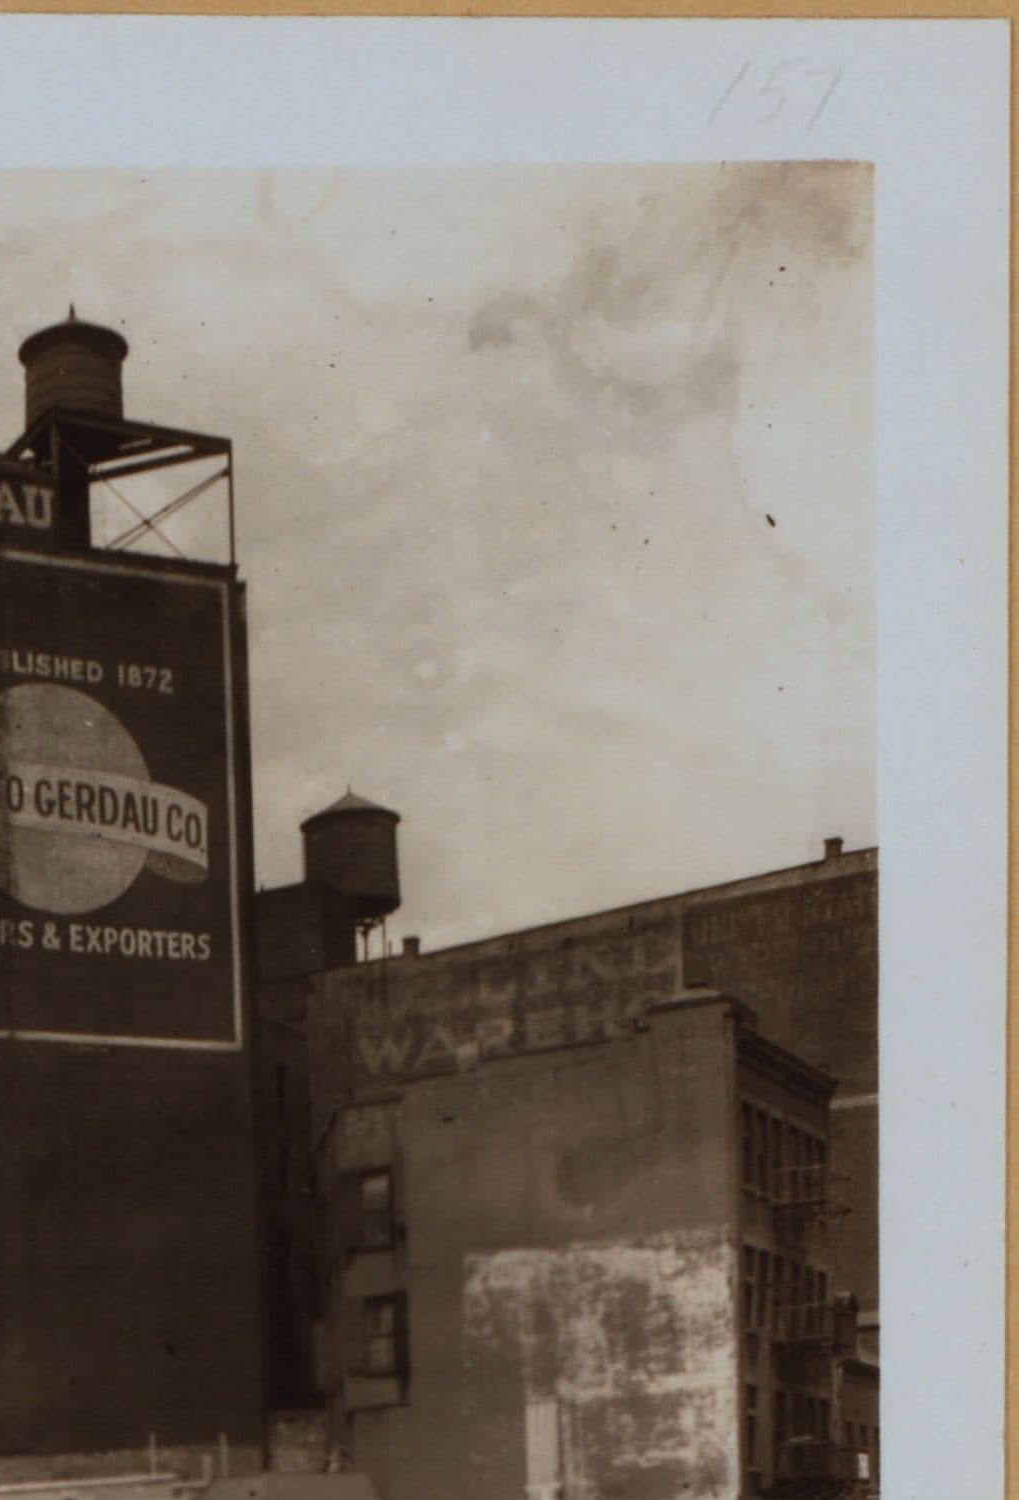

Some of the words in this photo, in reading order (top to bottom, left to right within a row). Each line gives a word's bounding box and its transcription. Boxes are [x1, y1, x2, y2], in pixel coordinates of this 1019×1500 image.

[705, 57, 843, 132] 157
[117, 664, 173, 694] 1872
[34, 779, 159, 837] GERDAU
[166, 803, 205, 853] CO.
[42, 921, 61, 951] &
[69, 924, 211, 961] EXPORTERS
